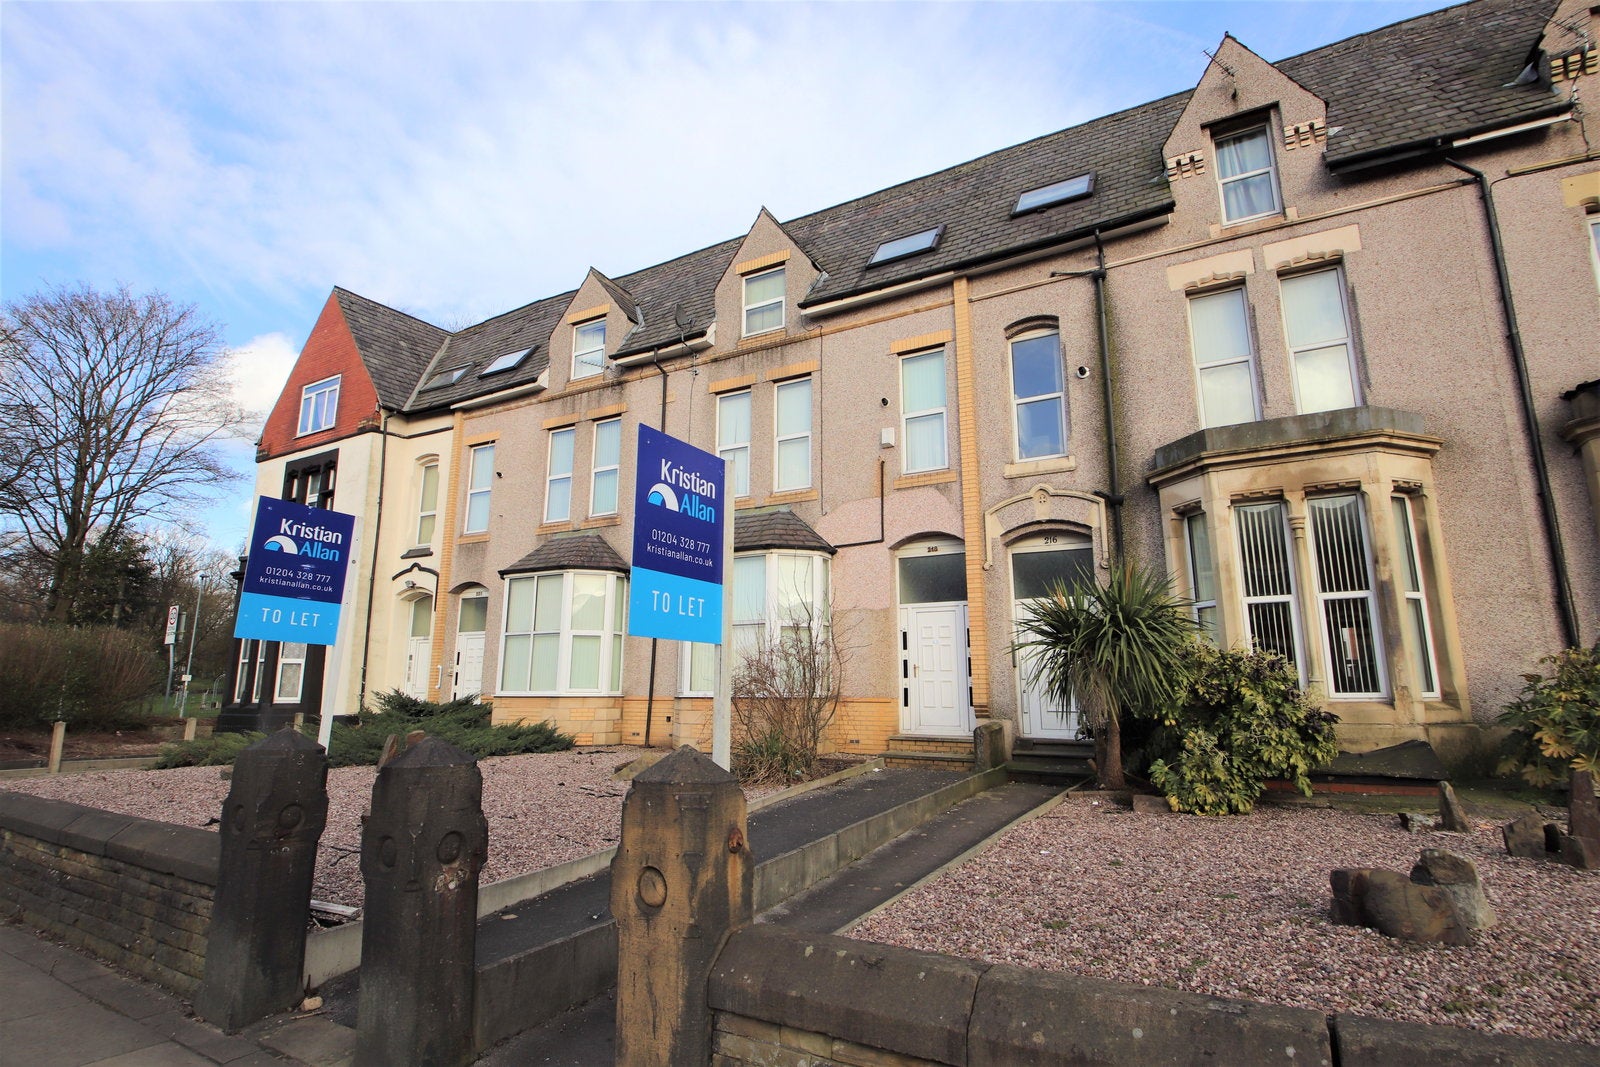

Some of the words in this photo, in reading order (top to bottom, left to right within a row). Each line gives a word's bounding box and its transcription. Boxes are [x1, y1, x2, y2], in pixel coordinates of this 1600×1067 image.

[661, 458, 715, 499] Kristian
[680, 493, 715, 523] Allan
[280, 518, 342, 544] Kristian
[652, 529, 678, 545] 01204
[680, 536, 695, 550] 328
[697, 541, 710, 554] 777
[1044, 536, 1058, 545] 216
[299, 541, 339, 562] Allan
[647, 543, 713, 567] kristianallan.co.uk
[260, 576, 333, 592] kristianallan.co.uk
[266, 566, 293, 578] 01204
[296, 570, 313, 580] 328
[316, 574, 331, 583] 777
[652, 590, 670, 613] TO
[678, 595, 704, 617] LET
[262, 608, 281, 624] TO
[290, 612, 320, 627] LET
